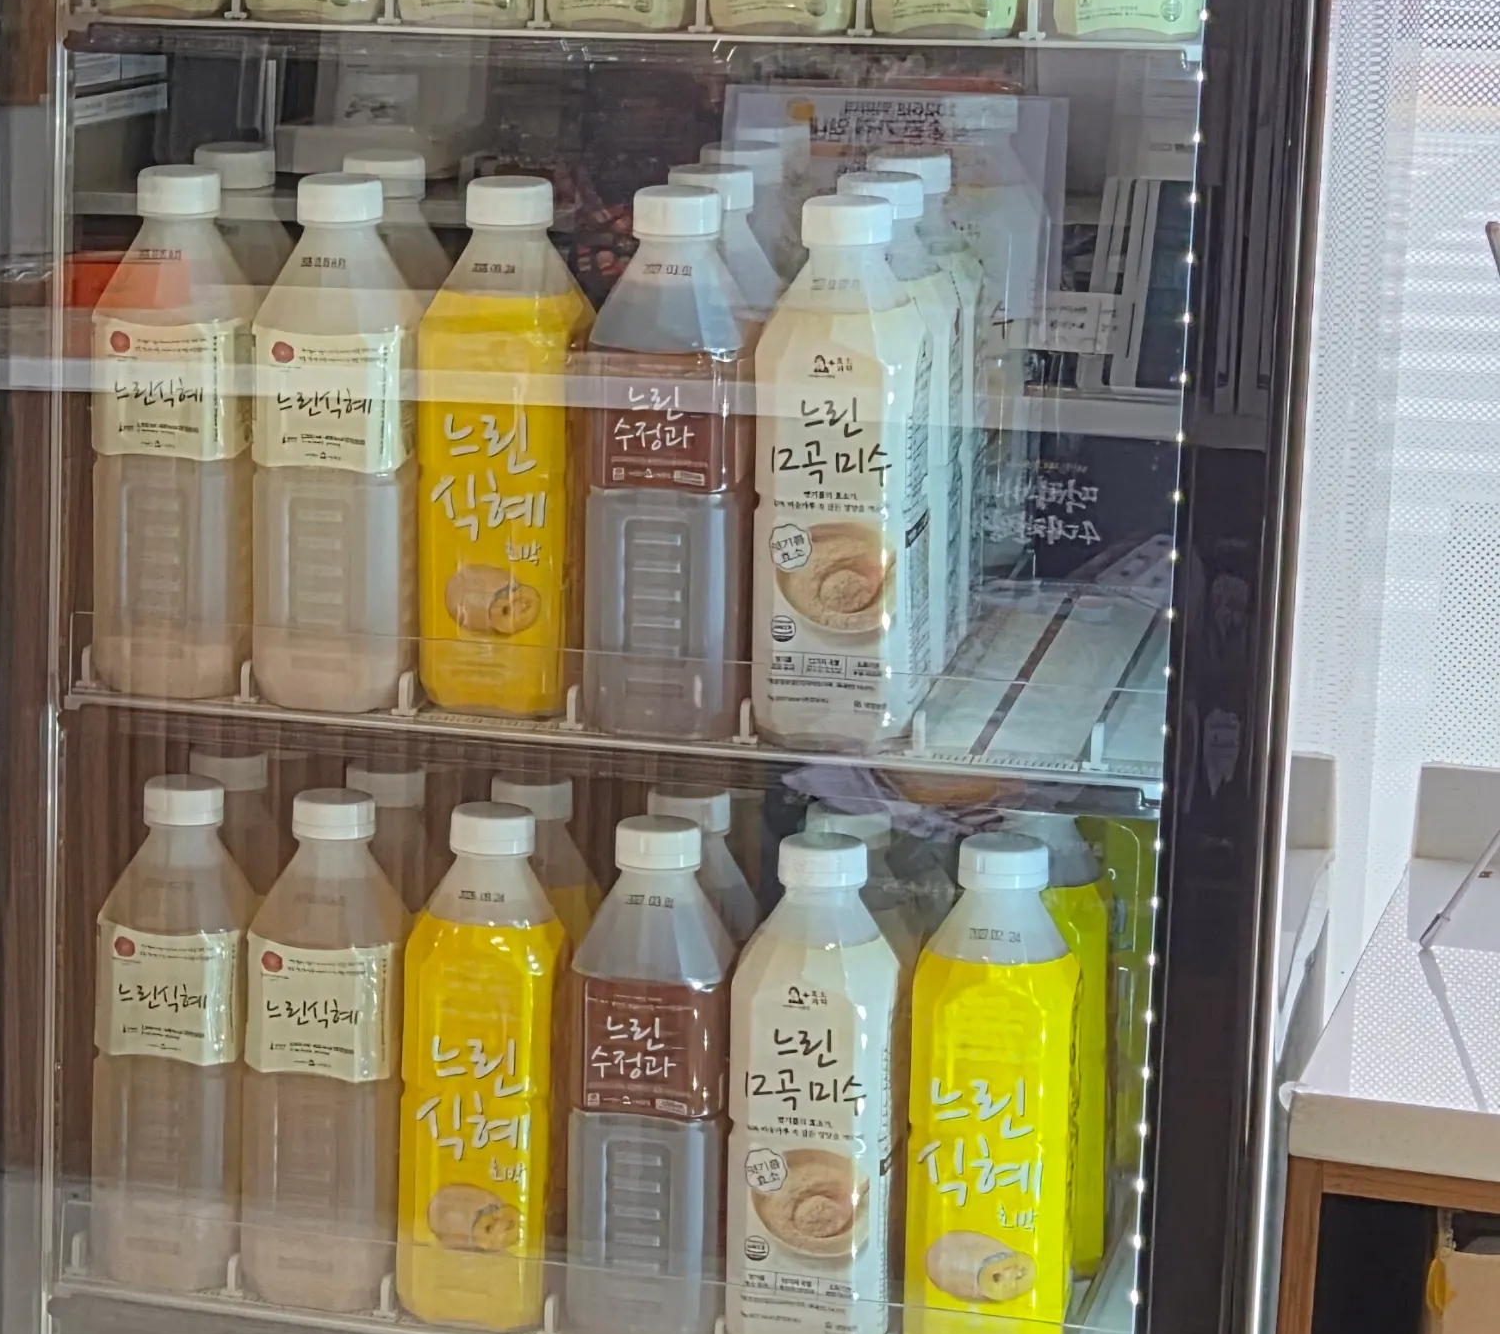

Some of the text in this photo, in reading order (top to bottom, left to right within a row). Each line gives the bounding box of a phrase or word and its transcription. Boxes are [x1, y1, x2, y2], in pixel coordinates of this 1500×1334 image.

[114, 376, 204, 408] 느린식혜
[277, 386, 373, 419] 느린식혜
[628, 384, 682, 422] 느린
[613, 419, 695, 453] 수정과
[801, 396, 864, 440] 느린
[442, 412, 538, 476] 느린
[430, 469, 548, 543] 식혜
[118, 982, 207, 1013] 느린식혜
[266, 997, 360, 1029] 느린식혜
[605, 1015, 666, 1052] 느린
[773, 1028, 838, 1069] 느린
[431, 1034, 525, 1099] 느린
[591, 1044, 676, 1081] 수정과
[416, 1090, 532, 1162] 식혜
[929, 1077, 1034, 1141] 느린
[917, 1134, 1044, 1209] 식혜
